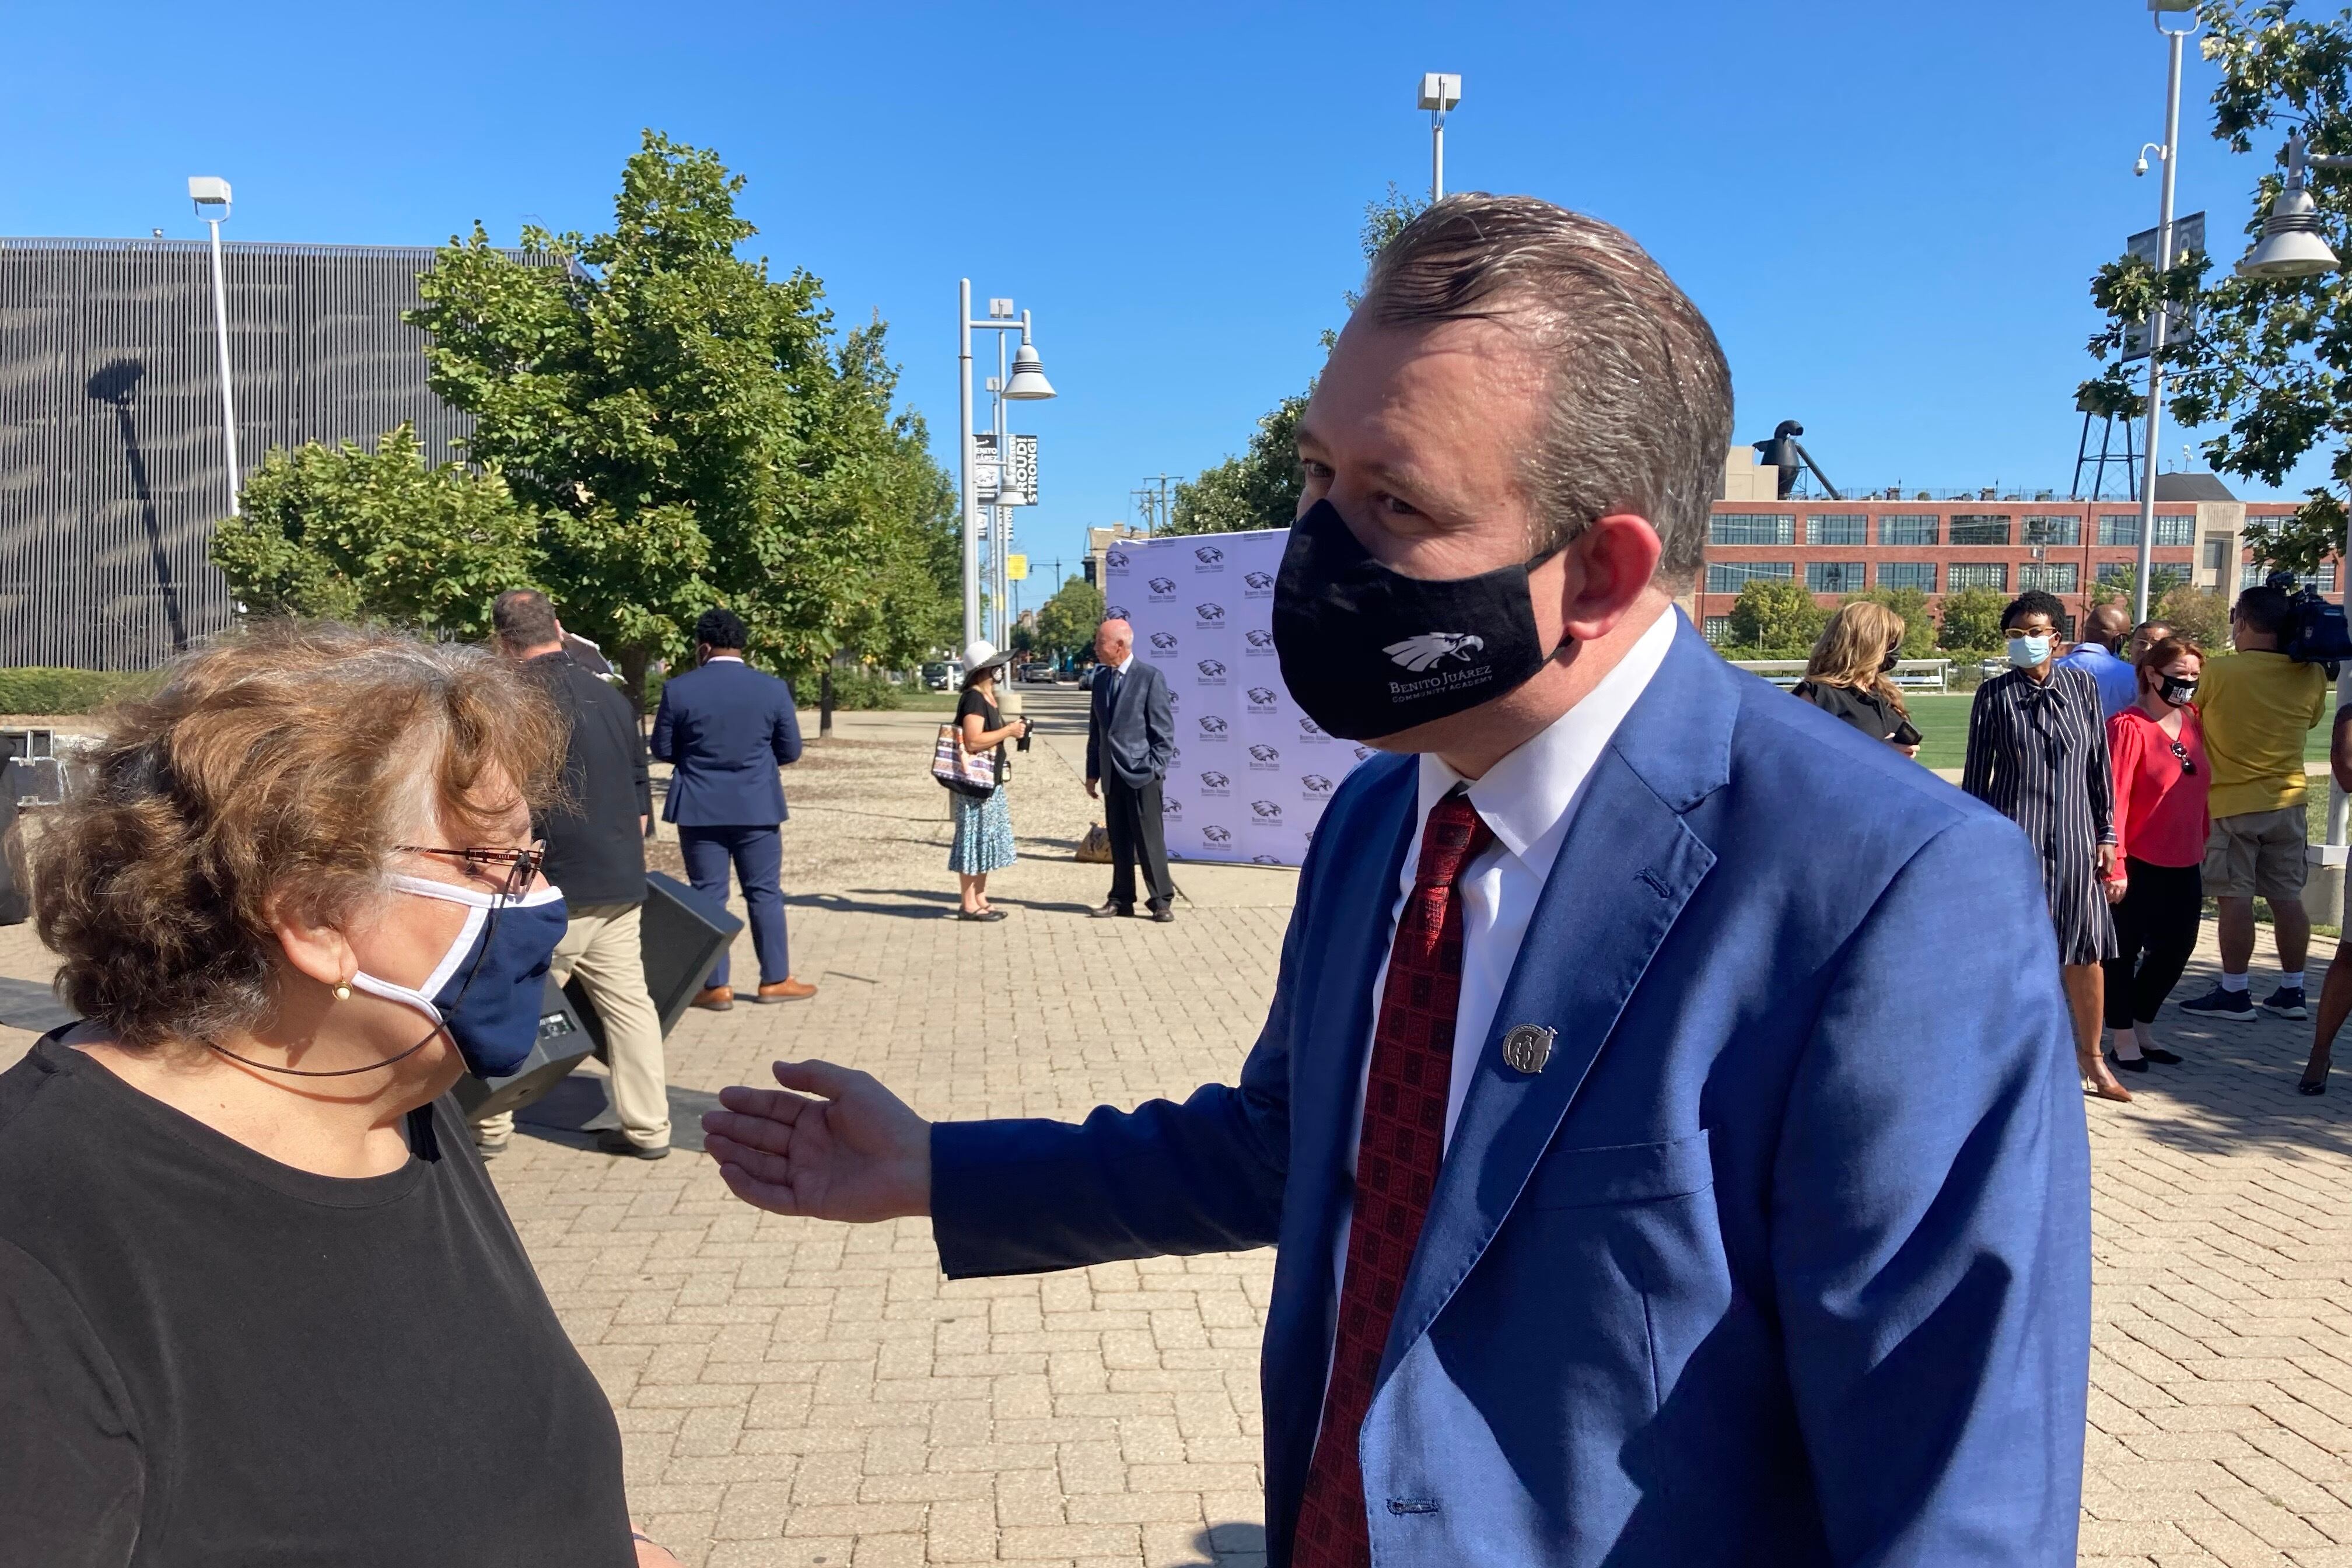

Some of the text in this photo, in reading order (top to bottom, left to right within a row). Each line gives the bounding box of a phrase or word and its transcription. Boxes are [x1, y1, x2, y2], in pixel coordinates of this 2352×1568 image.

[1017, 438, 1027, 501] ROUD!
[1027, 438, 1037, 502] STRONG!
[1388, 677, 1440, 694] BENITO
[1392, 676, 1493, 703] COMMUNITY ACADEMY
